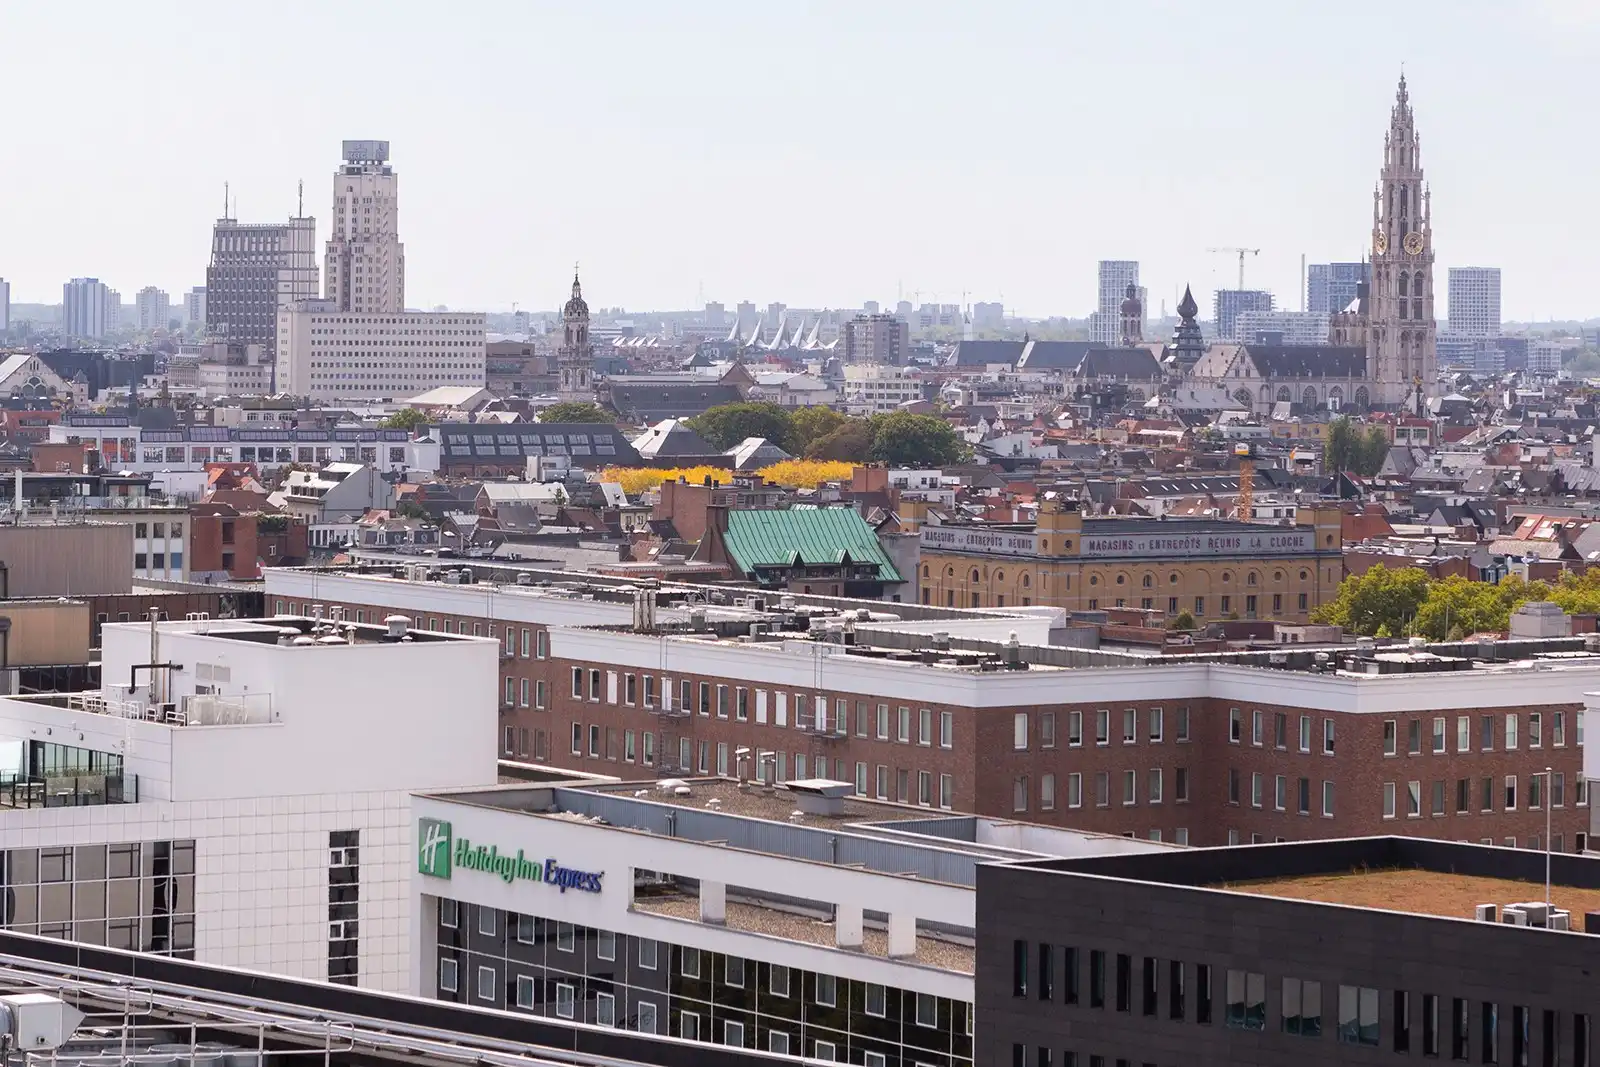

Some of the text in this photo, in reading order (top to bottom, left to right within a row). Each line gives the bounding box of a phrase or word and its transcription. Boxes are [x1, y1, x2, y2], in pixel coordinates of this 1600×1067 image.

[1089, 540, 1134, 551] MAGASINS
[1149, 536, 1201, 550] ENTREPÔTS
[1250, 536, 1262, 547] LA
[1270, 536, 1305, 547] CLOCHE
[454, 838, 604, 893] Holiday Inn Express
